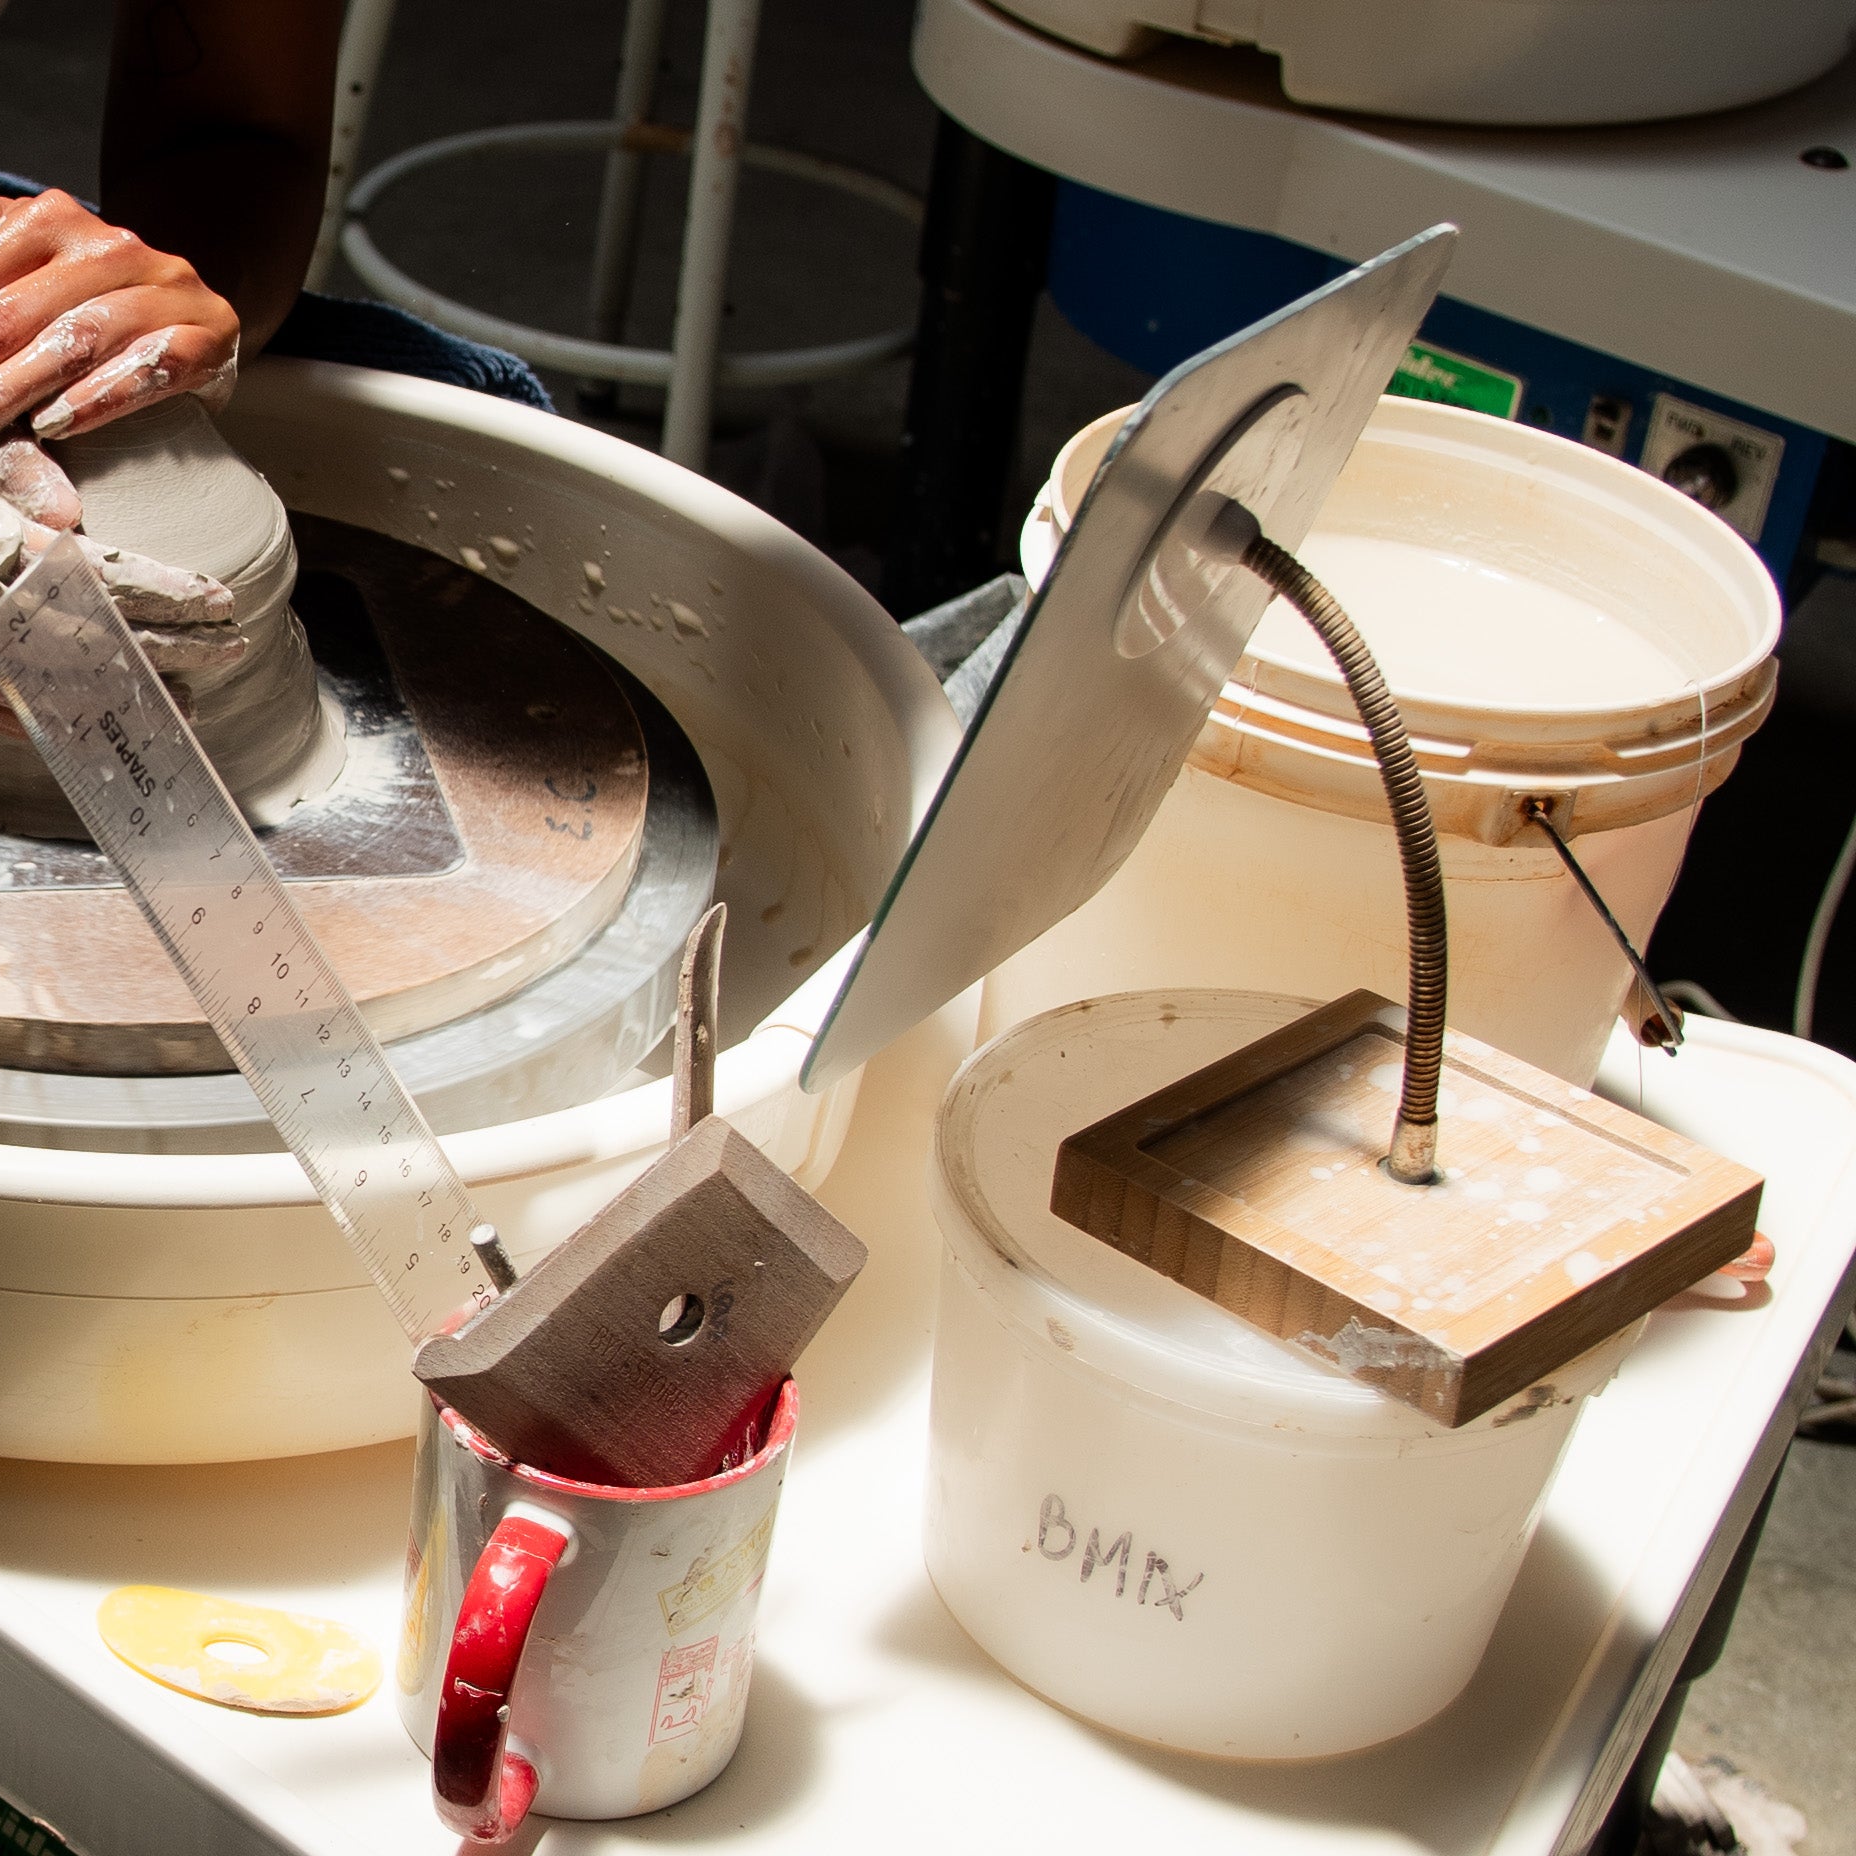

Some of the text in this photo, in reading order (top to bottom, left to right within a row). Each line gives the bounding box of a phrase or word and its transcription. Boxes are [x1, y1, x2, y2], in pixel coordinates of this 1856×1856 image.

[8, 609, 32, 644] 12
[70, 713, 93, 743] 11
[98, 709, 157, 799] STAPLES
[129, 806, 152, 838] 10
[47, 585, 60, 600] 0
[94, 662, 108, 678] 2
[118, 700, 131, 715] 3
[163, 775, 177, 791] 5
[186, 813, 199, 828] 6
[209, 848, 222, 861] 7
[230, 885, 243, 900] 8
[252, 920, 264, 935] 9
[270, 952, 290, 980] 10
[294, 988, 309, 1009] 11
[315, 1023, 331, 1045] 12
[336, 1057, 352, 1079] 13
[356, 1091, 372, 1112] 14
[377, 1125, 393, 1145] 15
[398, 1157, 412, 1179] 16
[417, 1191, 433, 1209] 17
[437, 1223, 452, 1243] 18
[456, 1254, 471, 1275] 19
[471, 1283, 491, 1311] 20
[247, 996, 262, 1015] 8
[300, 1087, 316, 1105] 7
[404, 1252, 420, 1271] 5
